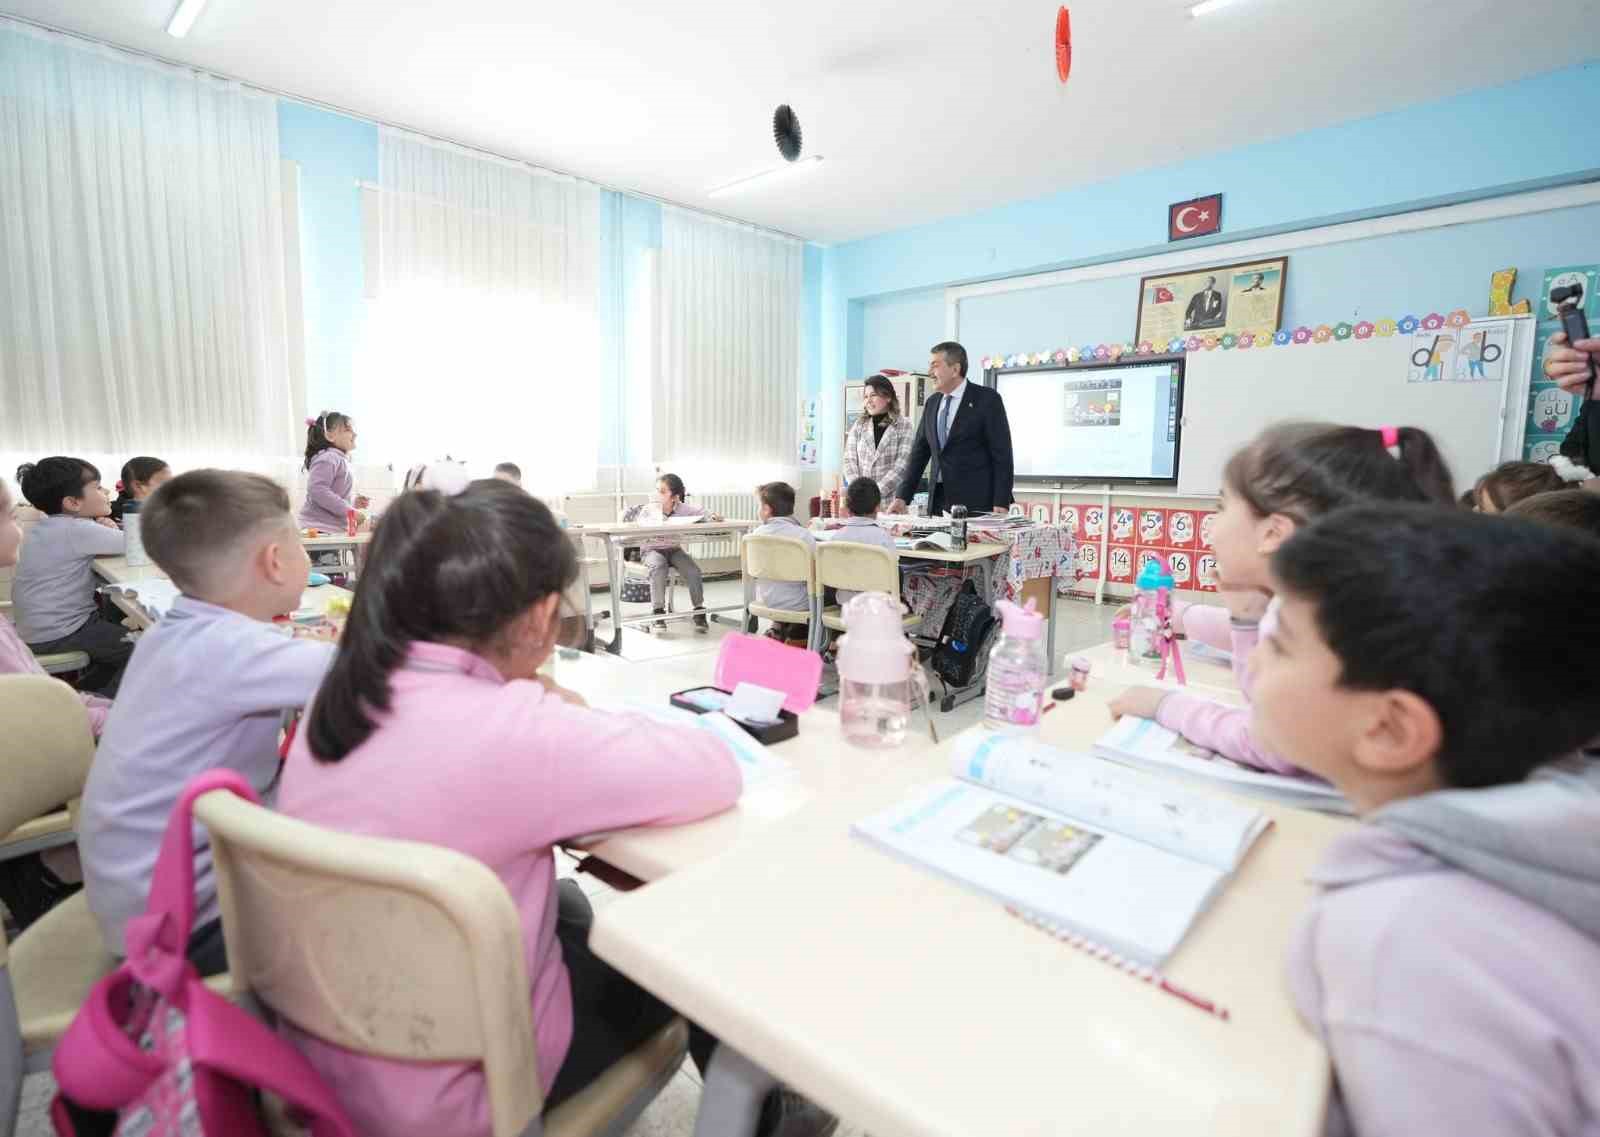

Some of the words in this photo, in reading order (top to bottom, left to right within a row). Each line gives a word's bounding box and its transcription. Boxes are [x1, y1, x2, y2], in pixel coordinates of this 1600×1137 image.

[1412, 335, 1440, 367] d
[1480, 331, 1502, 363] b
[1065, 510, 1074, 523] 2
[1091, 511, 1099, 525] 3
[1117, 512, 1128, 527] 4
[1147, 513, 1156, 529] 5
[1176, 514, 1186, 531] 6
[1083, 548, 1095, 562] 13
[1113, 551, 1128, 566] 14
[1172, 556, 1187, 571] 16
